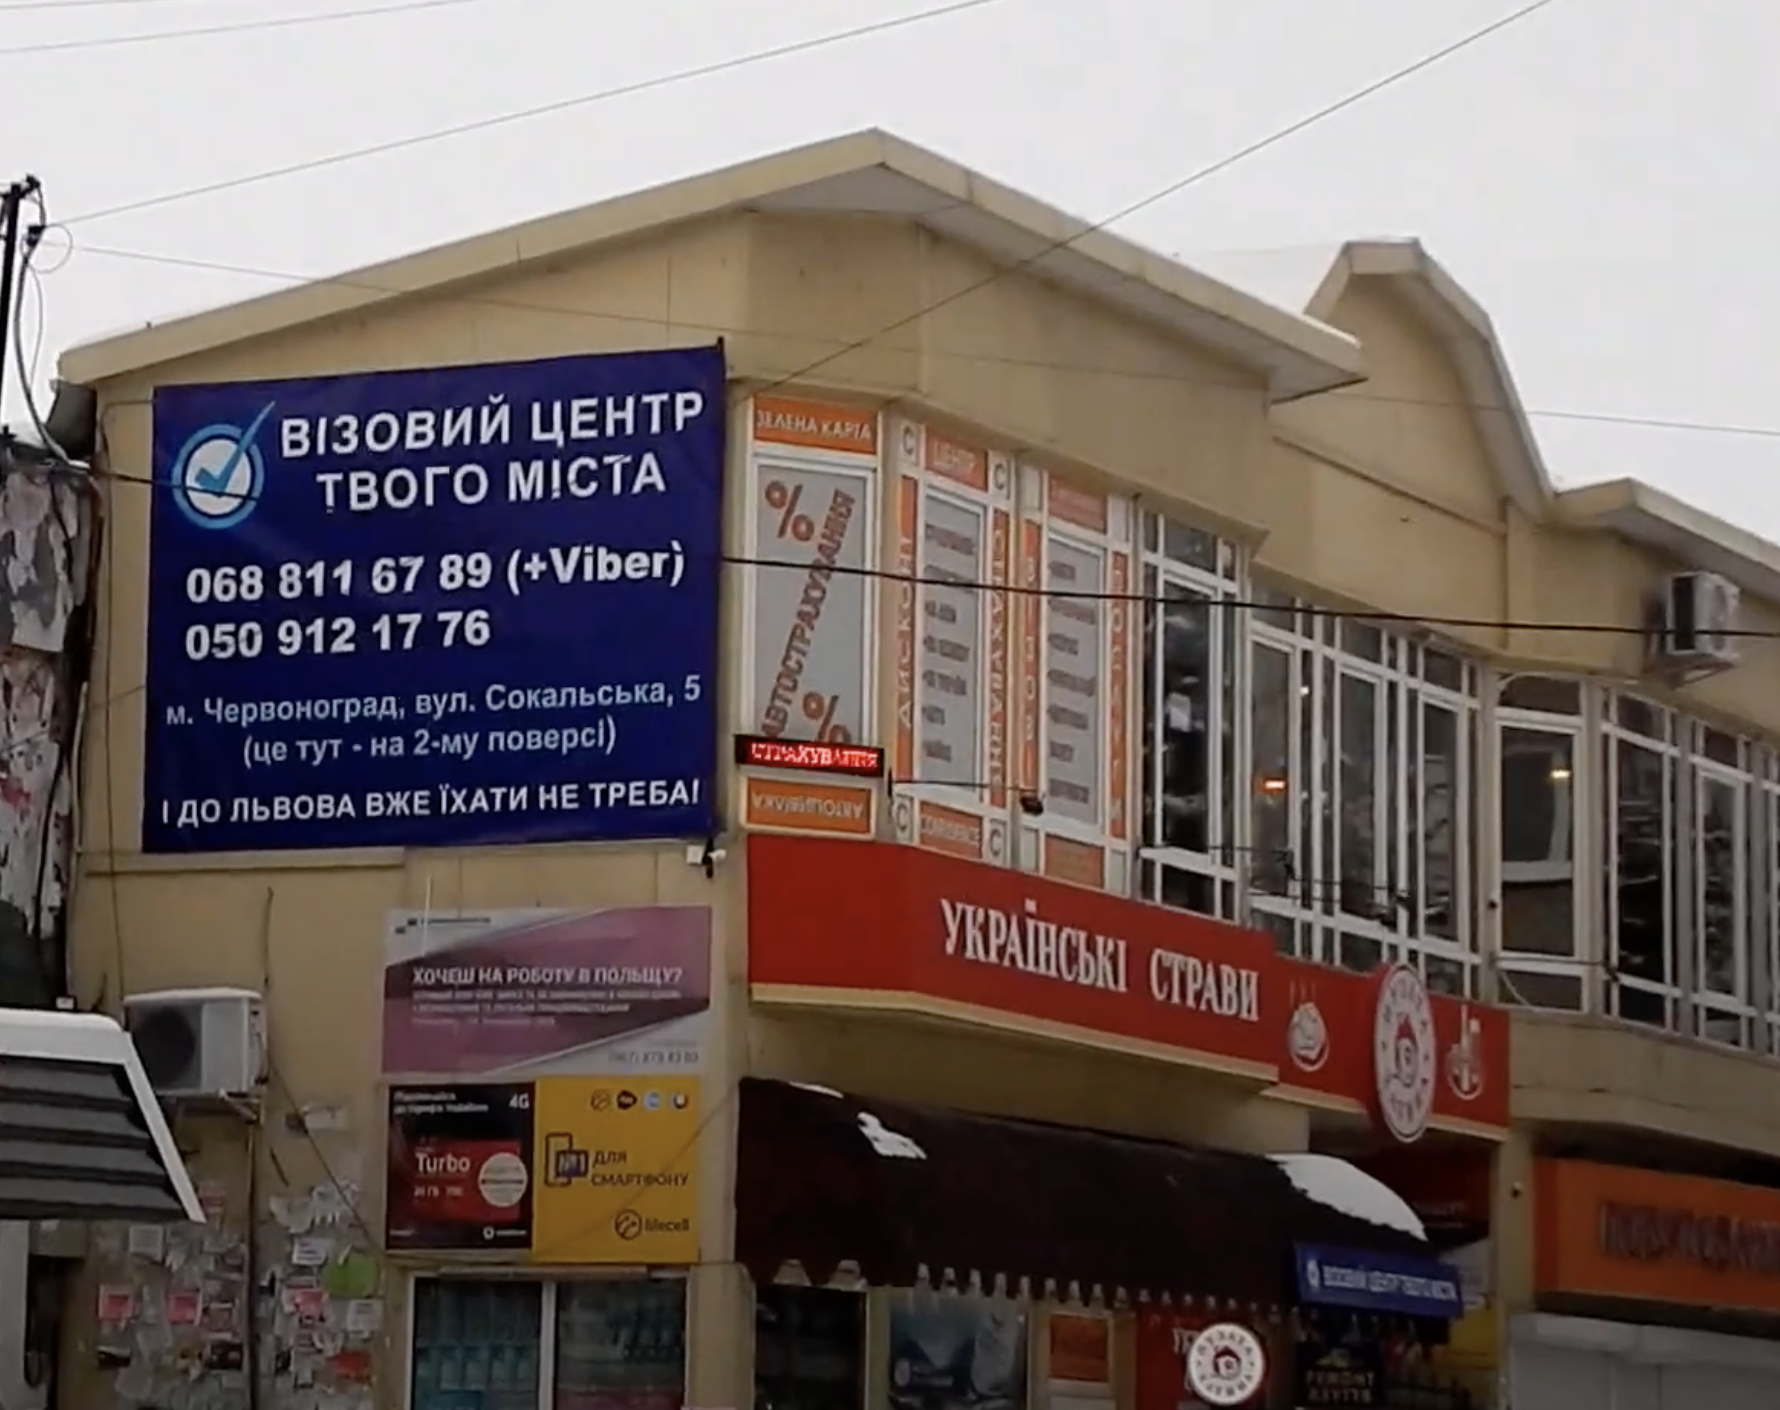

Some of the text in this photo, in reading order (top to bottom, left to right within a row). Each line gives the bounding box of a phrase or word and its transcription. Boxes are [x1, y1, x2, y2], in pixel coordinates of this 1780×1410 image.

[282, 392, 702, 457] ВІЗОВИЙ ЦЕНТР
[757, 409, 872, 440] ЗЕЛЕНА КАРТА
[316, 453, 665, 512] ТВОГО МІСТА
[187, 540, 683, 602] 068 811 67 89 (+Viber)
[186, 610, 489, 659] 050 912 17 76
[167, 675, 700, 727] м. Червоноград, вул. Сокальська, 5
[243, 736, 286, 769] (це
[296, 739, 342, 766] тут
[371, 736, 403, 756] на
[414, 729, 479, 760] 2-му
[489, 716, 616, 754] поверсі)
[163, 800, 168, 823] І
[178, 799, 220, 827] ДО
[231, 794, 355, 821] ЛЬВОВА
[366, 790, 430, 816] ВЖЕ
[439, 784, 527, 814] ЇХАТИ
[539, 784, 579, 809] НЕ
[413, 965, 682, 988] ХОЧЕШ НА РОБОТУ В ПОЛЬЩУ?
[941, 898, 1260, 1022] УКРАЇНСЬКІ СТРАВИ
[508, 1093, 530, 1109] 4G
[415, 1152, 471, 1173] Turbo
[591, 1173, 689, 1187] СМАРТФОНУ
[592, 1150, 627, 1168] ДЛЯ
